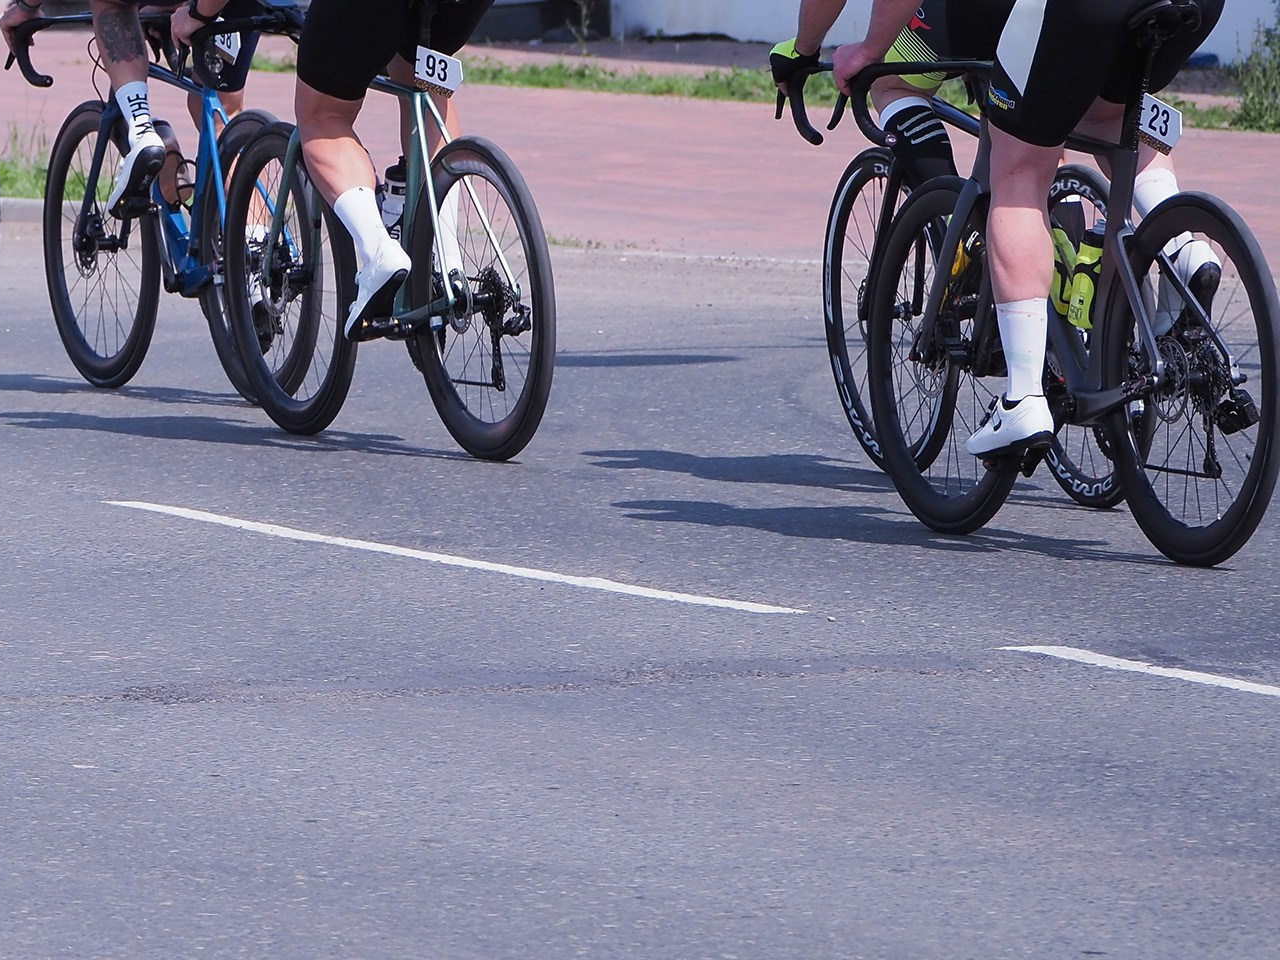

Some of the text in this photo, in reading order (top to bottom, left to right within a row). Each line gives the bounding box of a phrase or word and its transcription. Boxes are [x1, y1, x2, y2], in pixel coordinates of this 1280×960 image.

[425, 54, 448, 82] 93
[127, 93, 151, 123] THE
[1147, 104, 1170, 137] 23
[1046, 447, 1113, 497] DURA-AC
